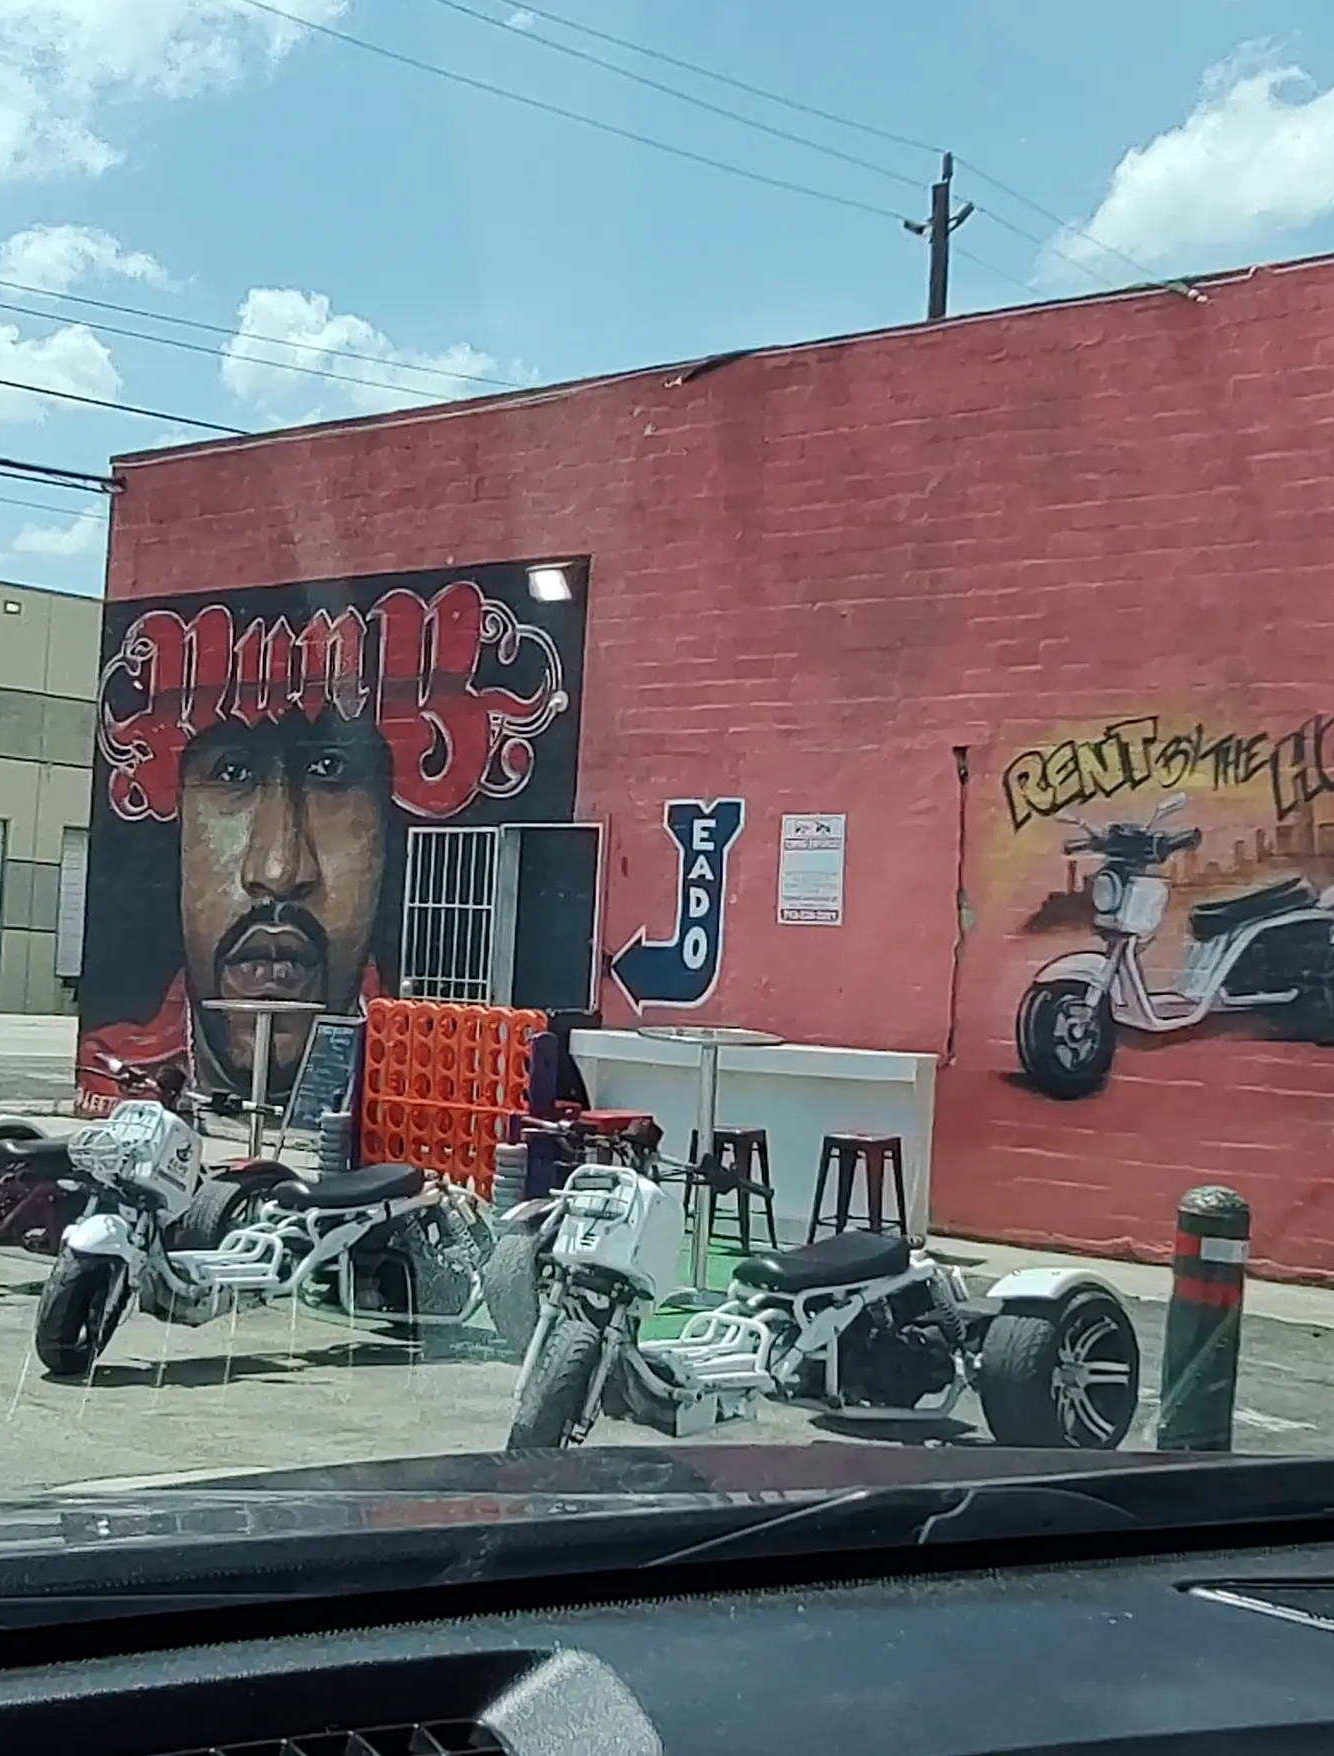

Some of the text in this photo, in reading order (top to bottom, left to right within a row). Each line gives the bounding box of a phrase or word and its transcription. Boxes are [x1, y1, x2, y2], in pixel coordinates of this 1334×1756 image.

[1002, 715, 1159, 834] RENT
[1201, 730, 1269, 791] THE
[682, 818, 717, 970] EADO
